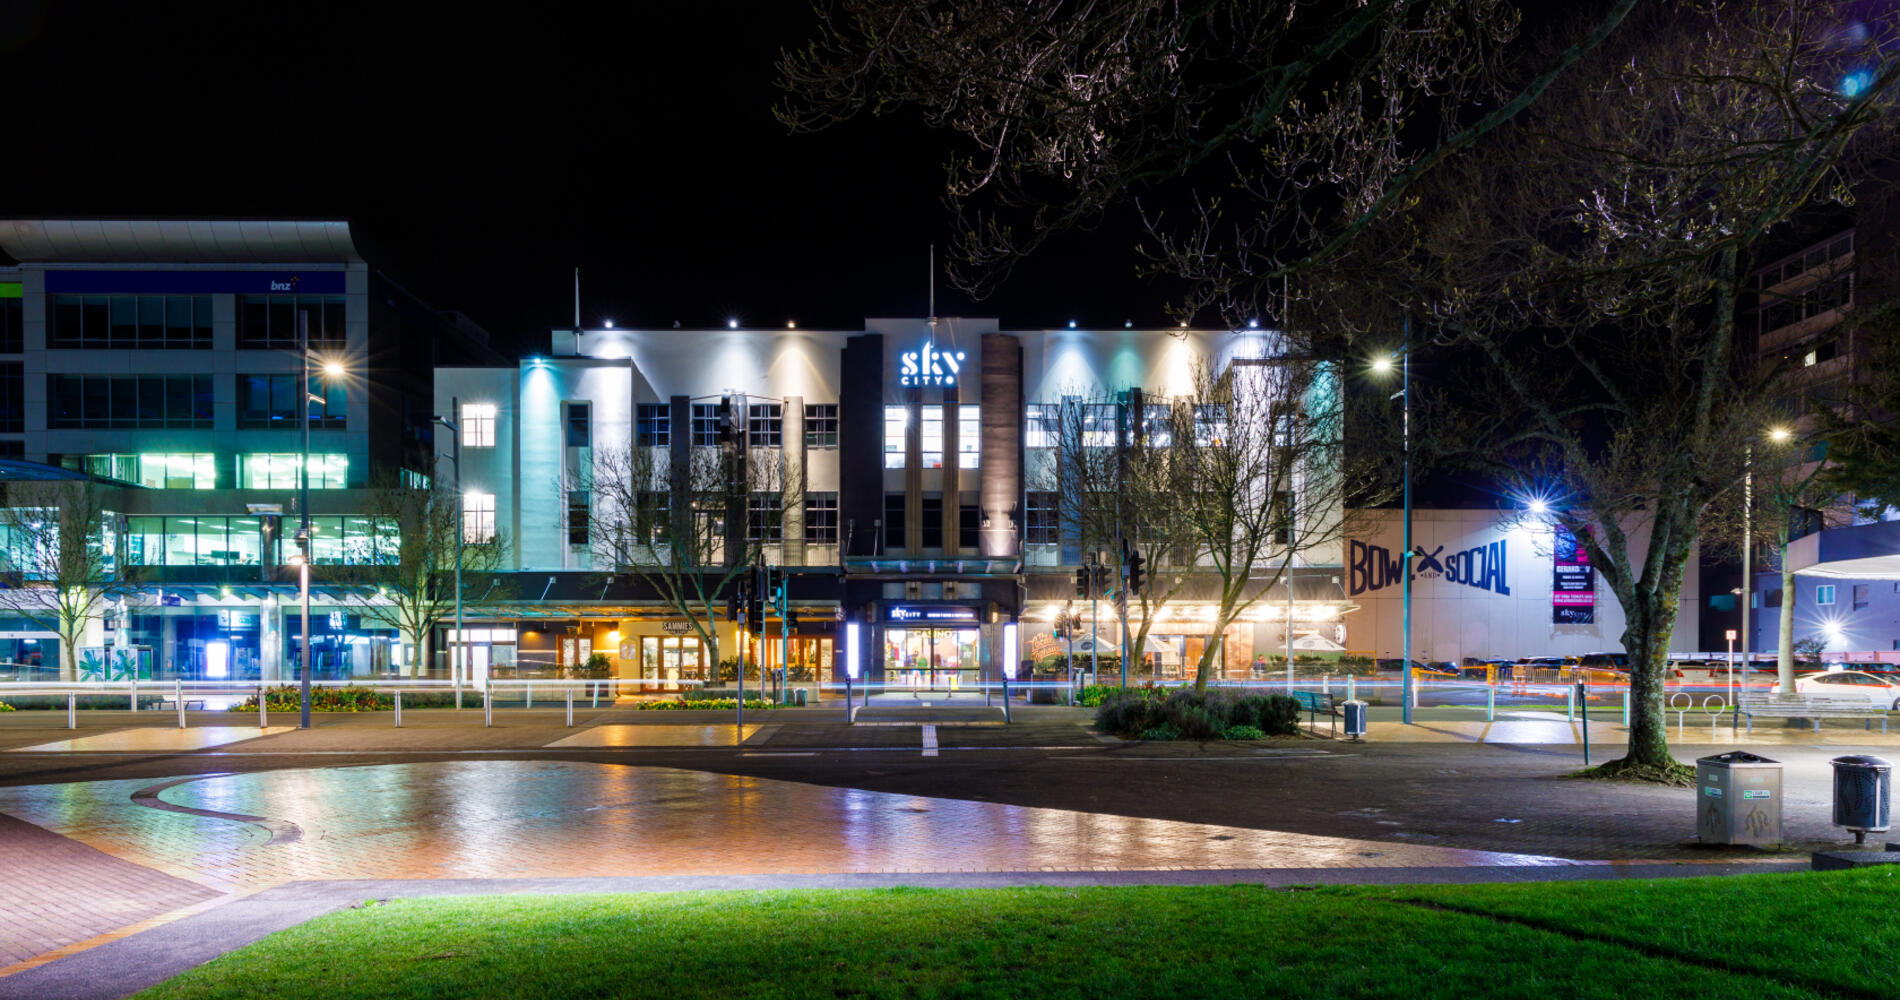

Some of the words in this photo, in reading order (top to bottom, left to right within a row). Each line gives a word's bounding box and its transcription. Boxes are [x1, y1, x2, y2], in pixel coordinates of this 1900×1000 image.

[271, 280, 291, 290] bnz
[901, 340, 966, 384] sky
[901, 376, 943, 385] CITY
[1350, 539, 1416, 595] BOW
[1445, 539, 1510, 596] SOCIAL
[663, 621, 694, 631] SAMMIES
[913, 630, 953, 639] CASINO
